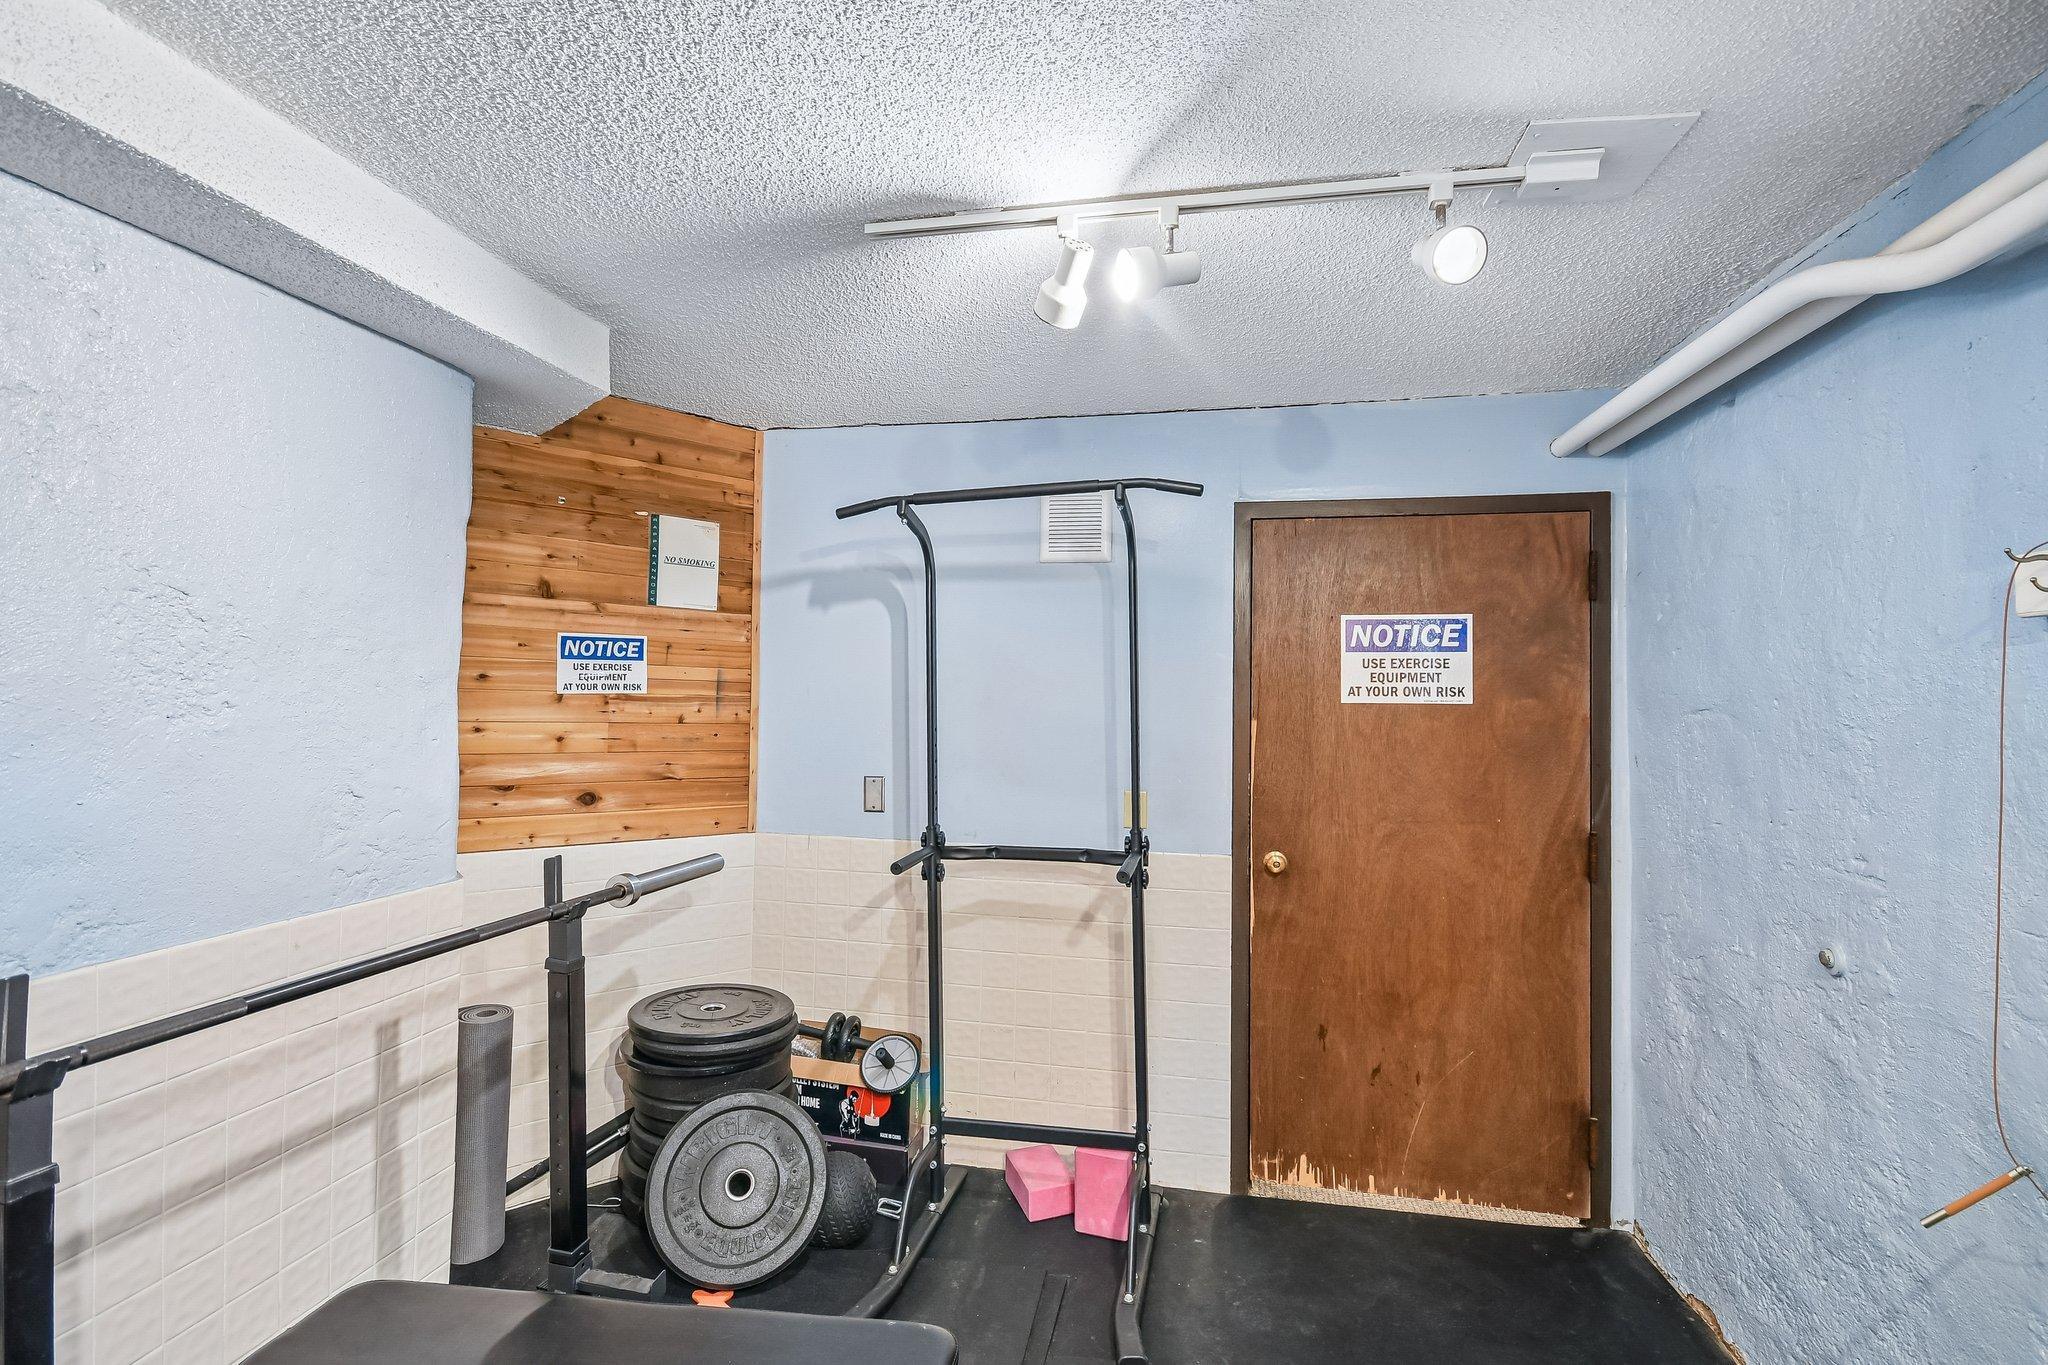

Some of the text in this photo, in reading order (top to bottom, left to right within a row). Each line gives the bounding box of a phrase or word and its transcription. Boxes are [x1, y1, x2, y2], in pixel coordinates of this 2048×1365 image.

[664, 555, 716, 568] NO SMOKING
[1350, 624, 1463, 648] NOTICE
[564, 639, 641, 658] NOTICE
[573, 662, 633, 671] USE EXERCISE
[1362, 658, 1451, 669] USE EXERCISE
[578, 673, 628, 682] EQUIPMENT
[1370, 672, 1442, 684] EQUIPMENT
[563, 683, 642, 691] AT YOUR OWN RISK
[1347, 686, 1466, 698] AT YOUR OWN RISK
[801, 1096, 820, 1108] HOME
